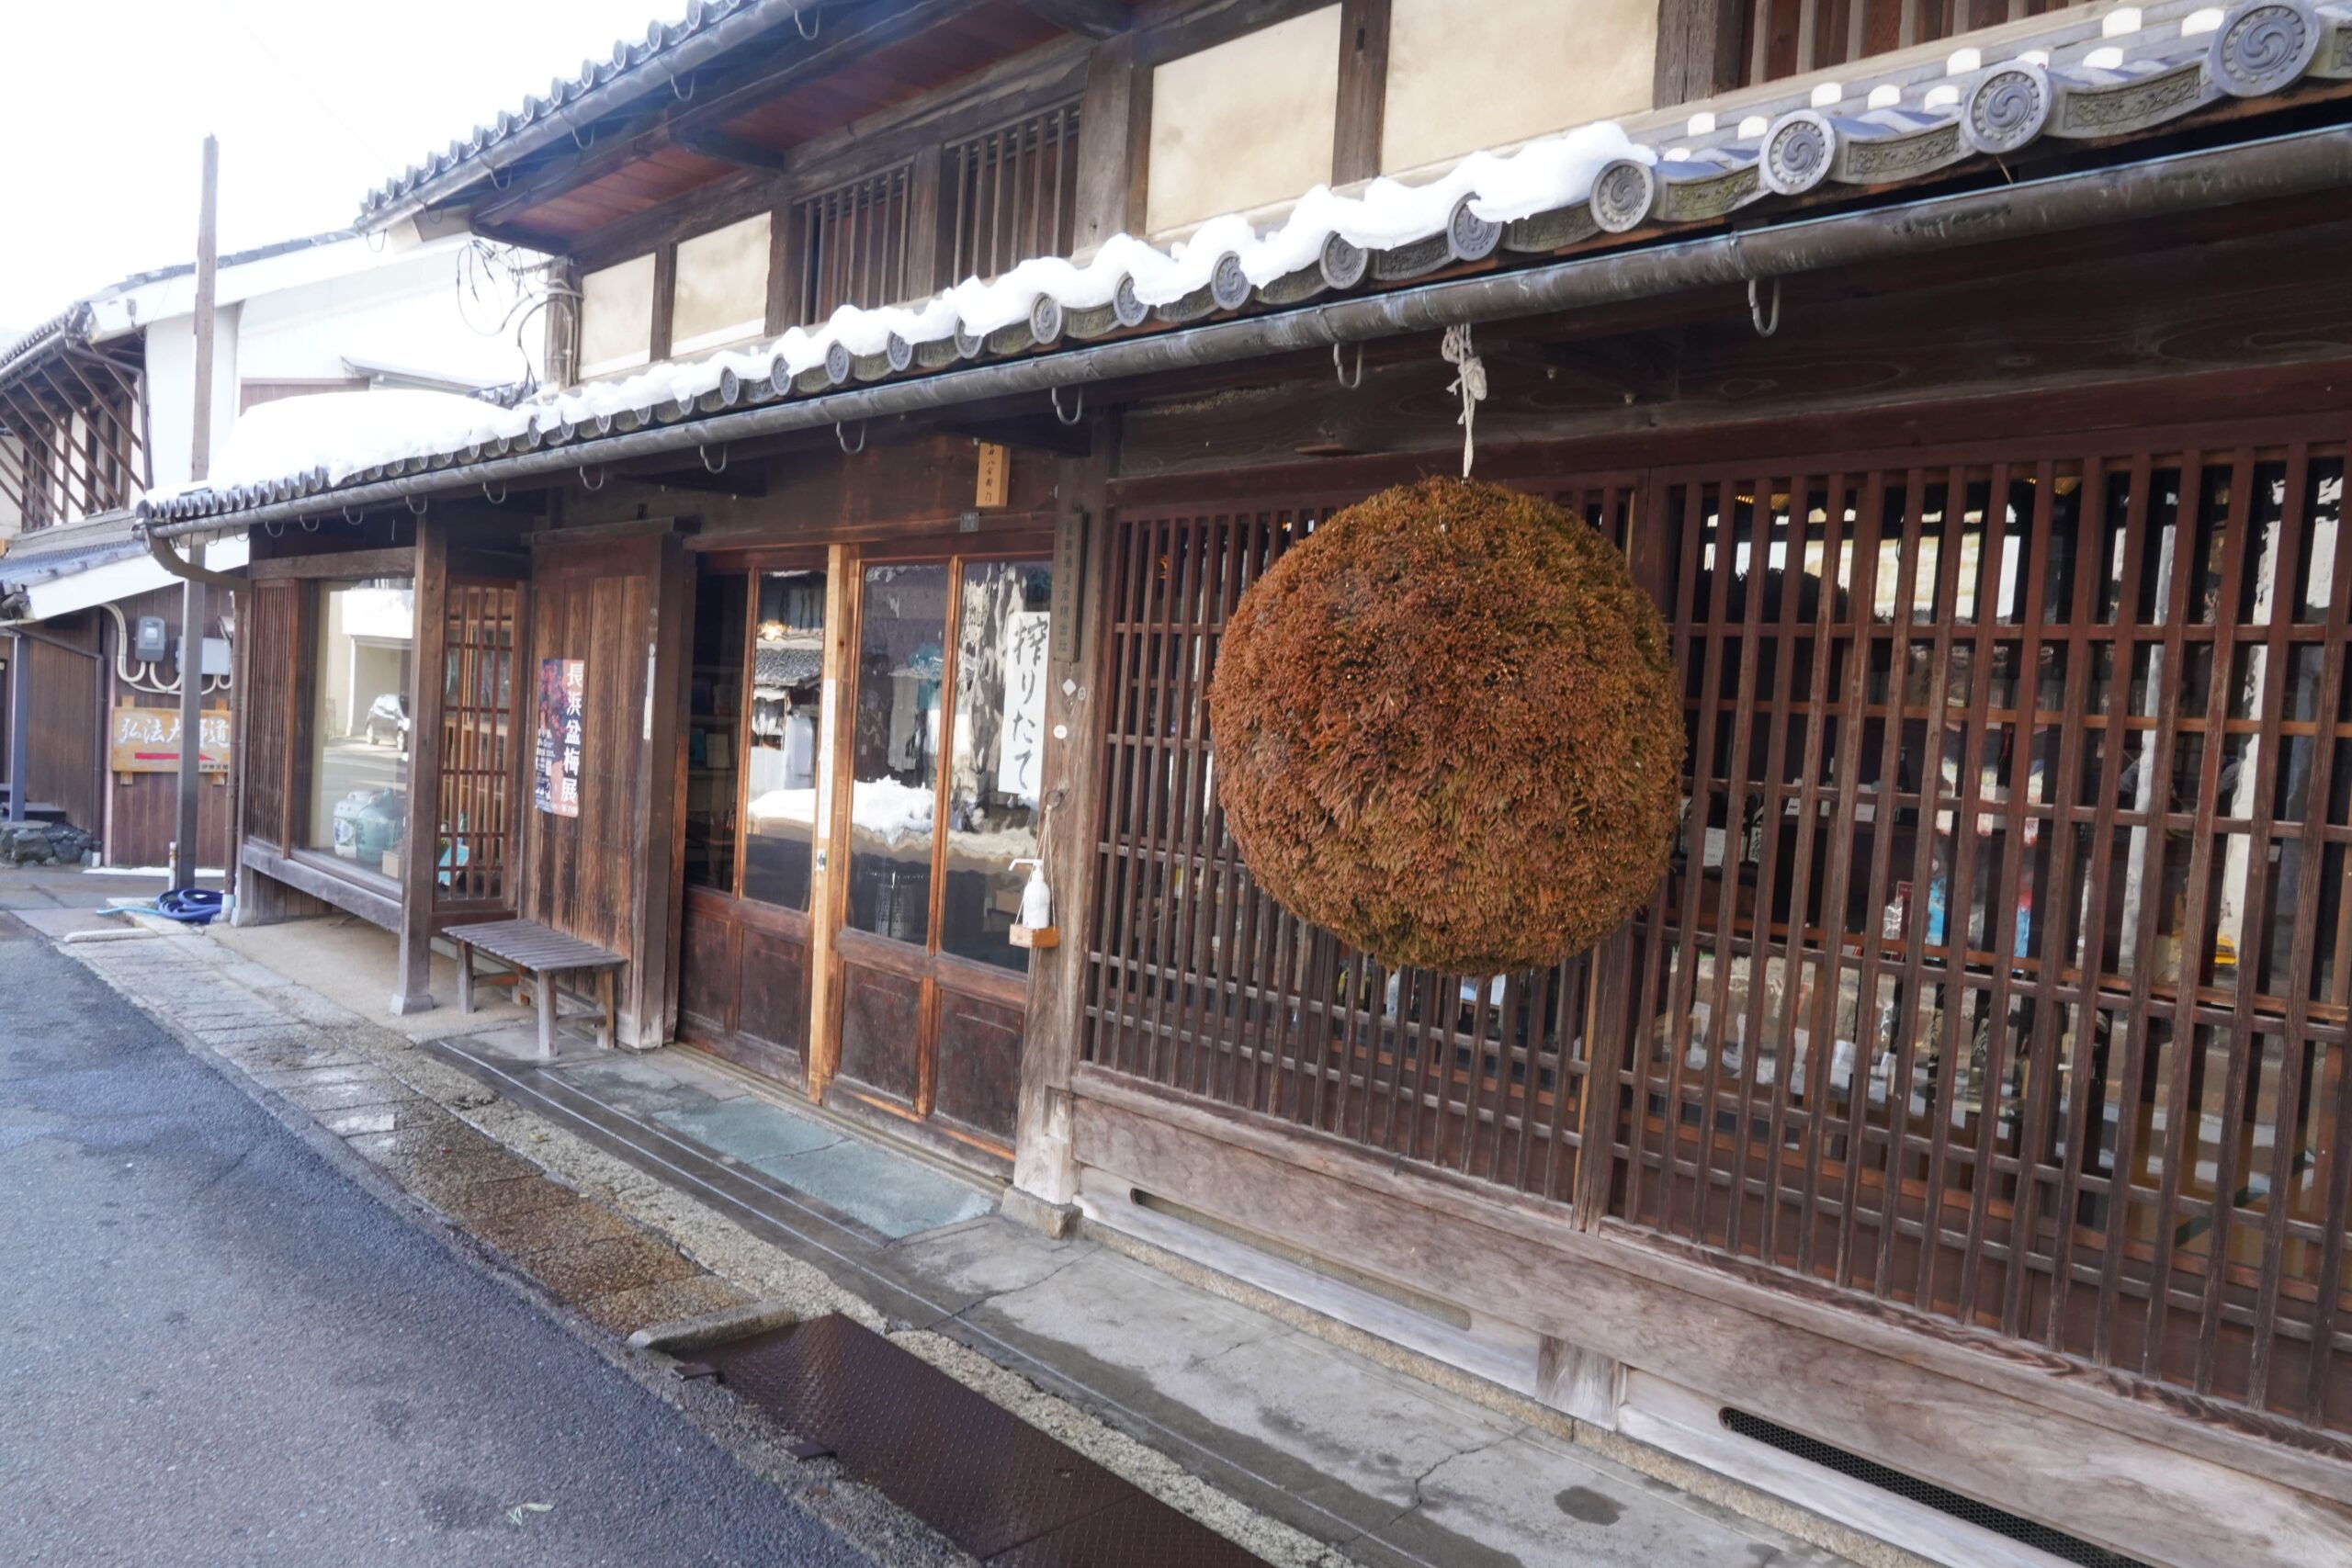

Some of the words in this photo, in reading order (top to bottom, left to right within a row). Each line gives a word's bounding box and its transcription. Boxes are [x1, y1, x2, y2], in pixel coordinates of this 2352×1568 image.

[561, 662, 584, 805] 長浜盆梅展
[1013, 615, 1049, 790] 搾りたて
